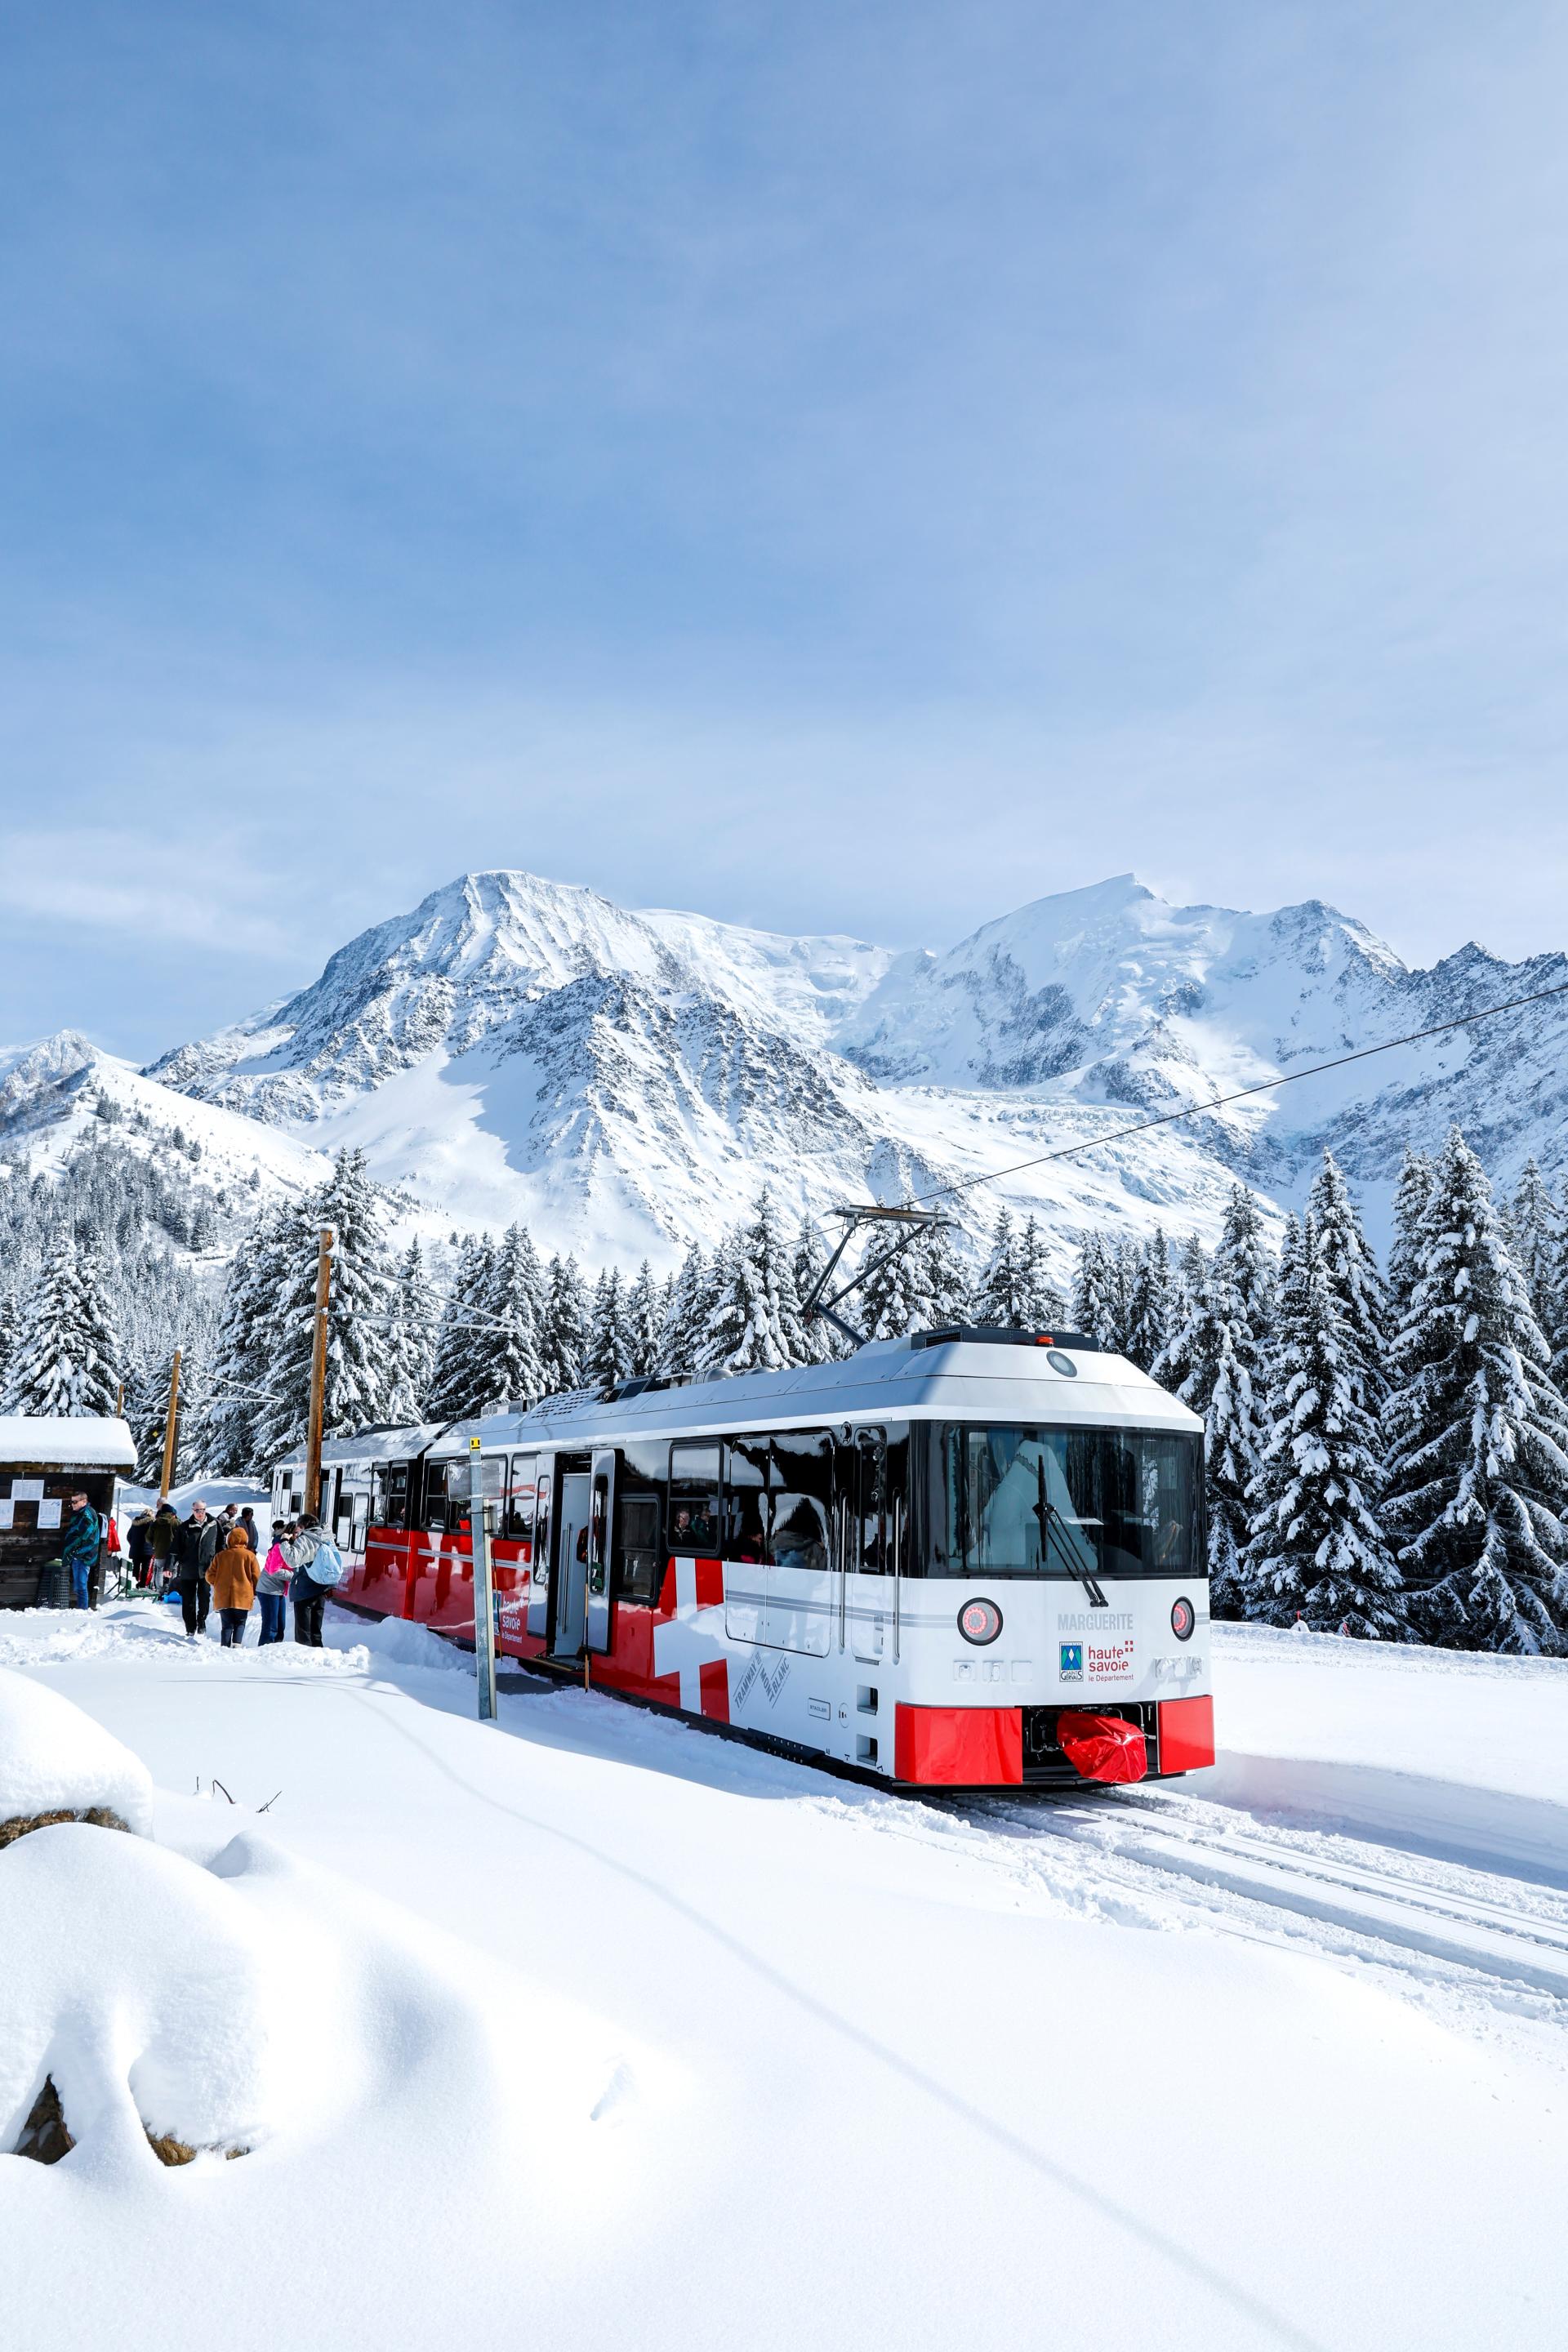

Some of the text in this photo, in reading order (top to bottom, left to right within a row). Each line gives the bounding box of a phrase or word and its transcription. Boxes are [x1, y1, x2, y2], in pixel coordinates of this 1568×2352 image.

[503, 1595, 519, 1615] haute
[502, 1615, 520, 1631] savoie
[1058, 1614, 1134, 1631] MARGUERITE
[1088, 1645, 1124, 1659] haute
[772, 1657, 790, 1694] BLANC
[1089, 1660, 1129, 1673] savoie
[735, 1660, 756, 1708] TRAMWAY
[760, 1668, 775, 1702] MONT
